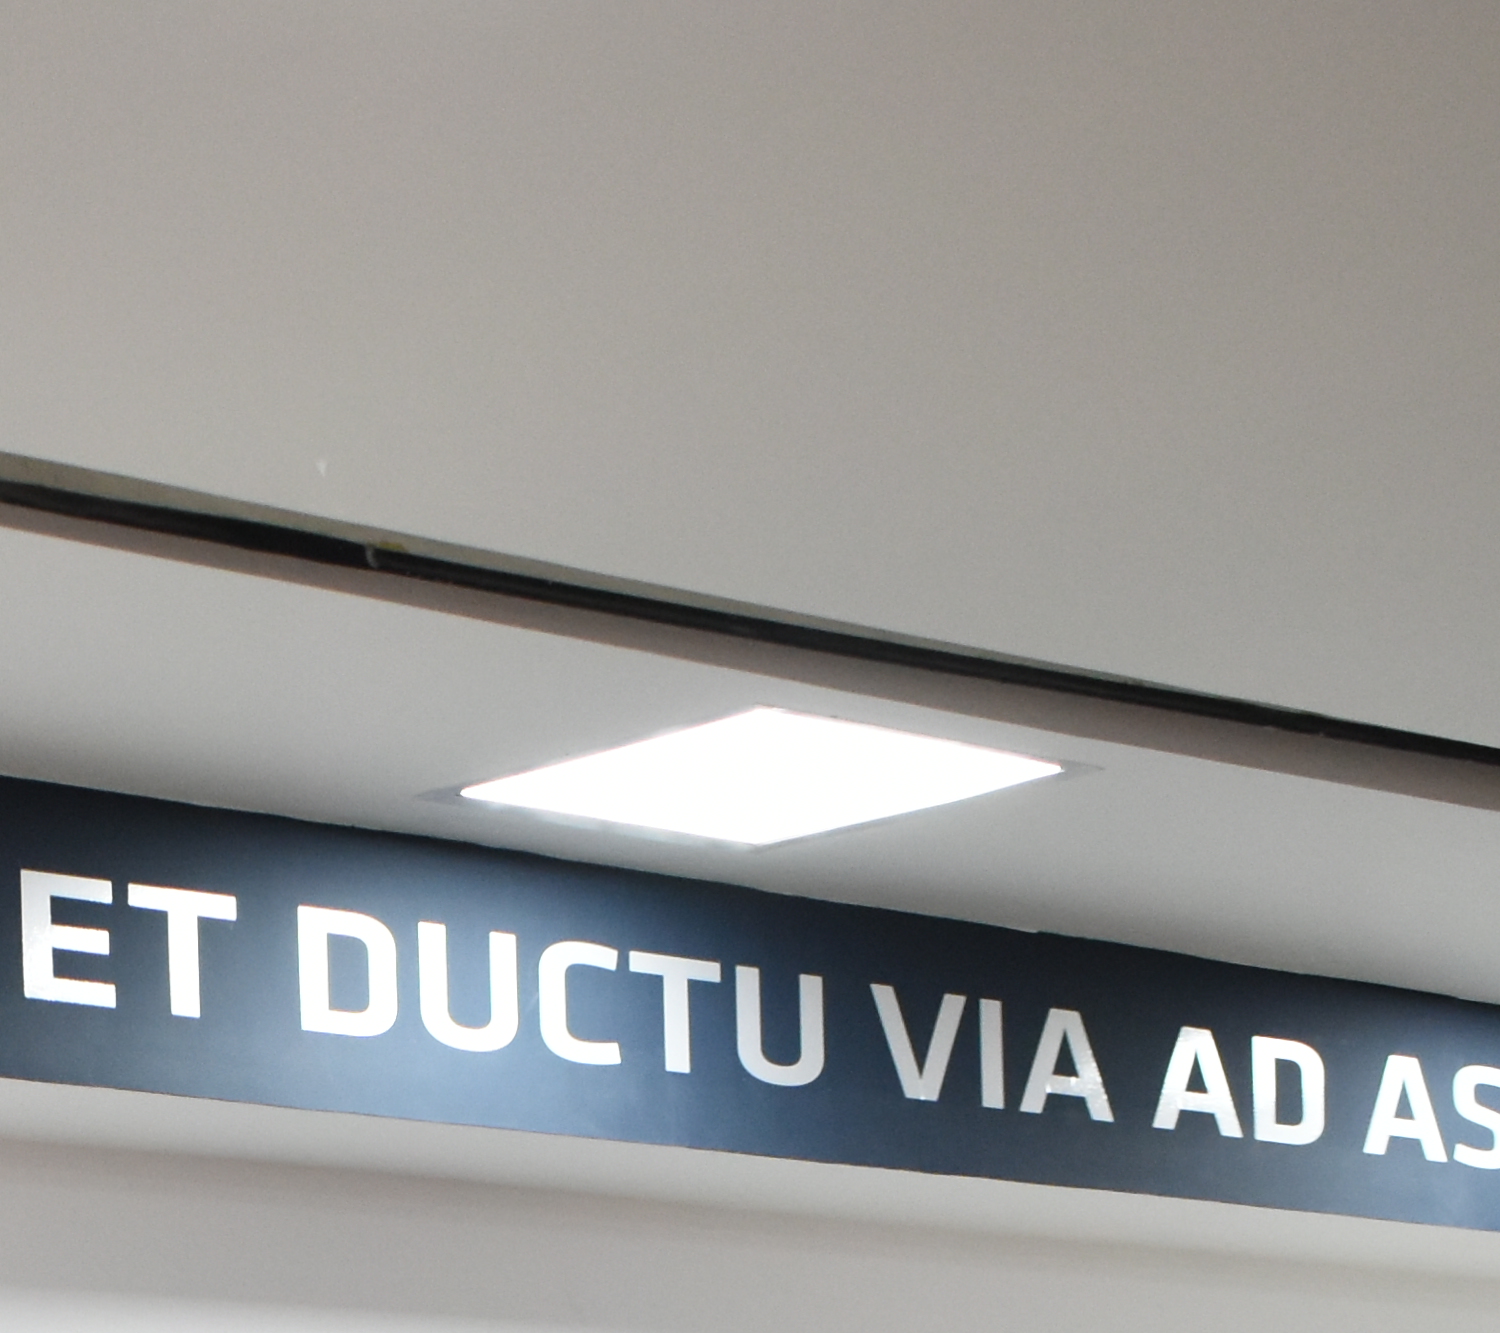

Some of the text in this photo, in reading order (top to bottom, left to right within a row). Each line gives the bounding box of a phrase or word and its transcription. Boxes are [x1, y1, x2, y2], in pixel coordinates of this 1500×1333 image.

[20, 867, 238, 1019] ET
[295, 904, 826, 1088] DUCTU
[870, 981, 1115, 1124] VIA
[1151, 1026, 1326, 1148] AD
